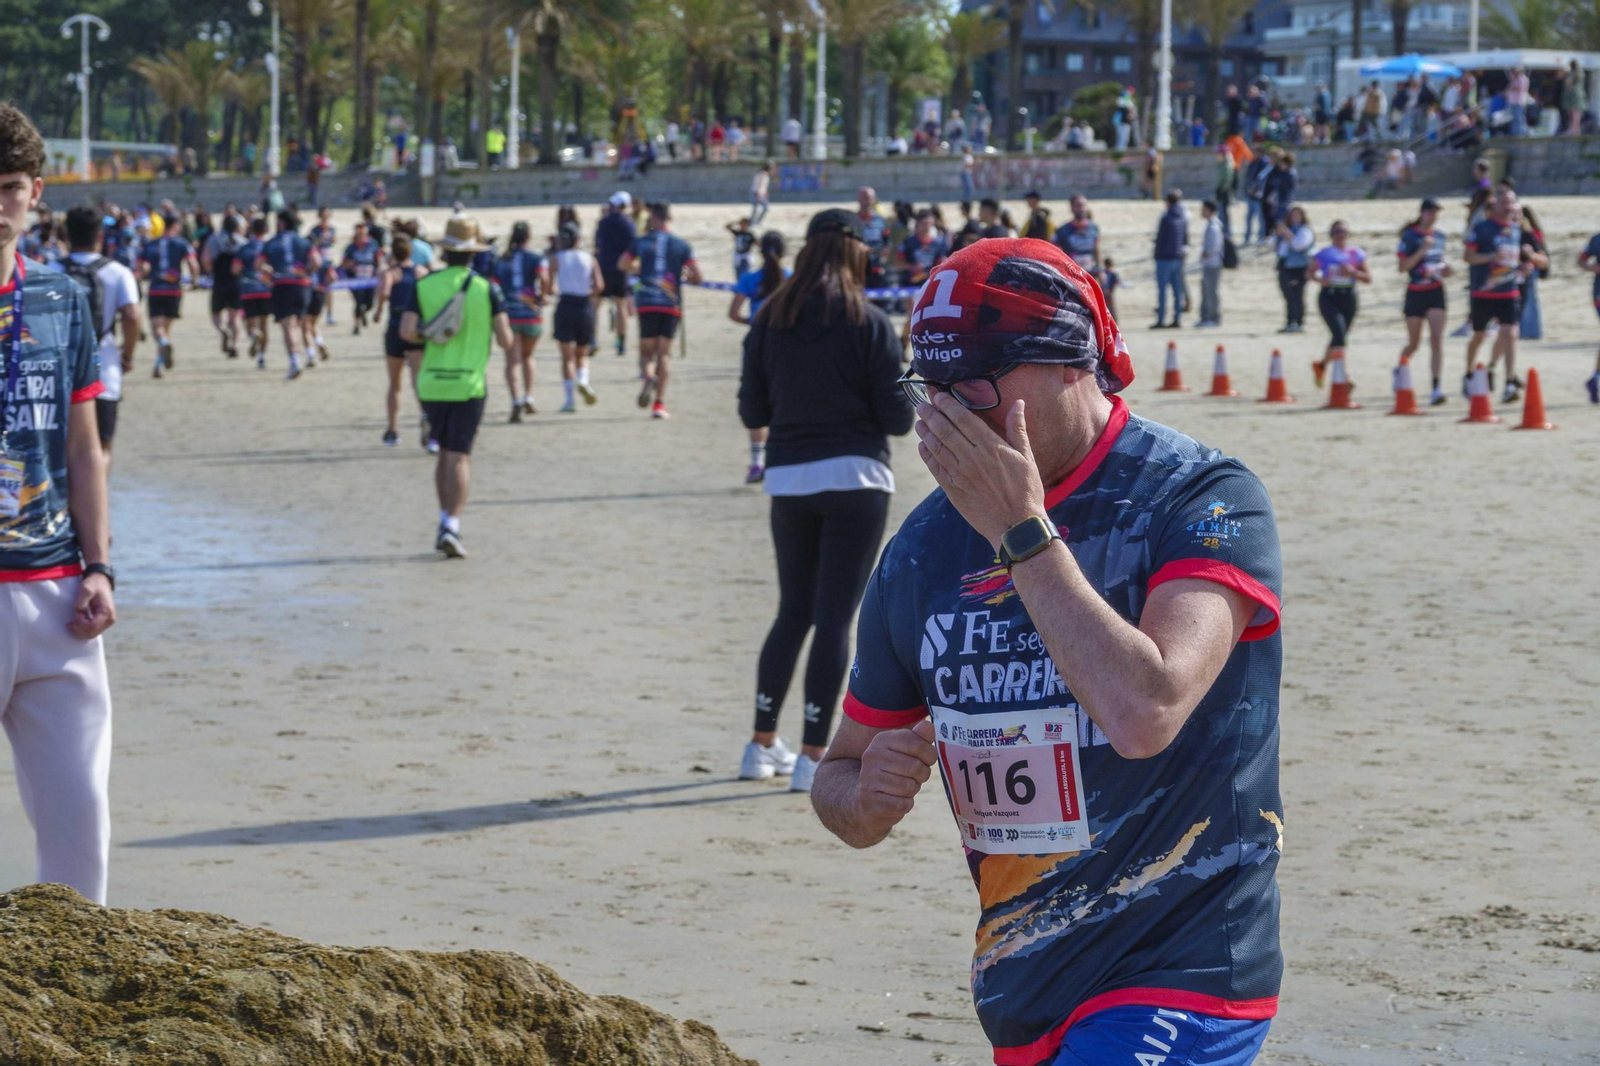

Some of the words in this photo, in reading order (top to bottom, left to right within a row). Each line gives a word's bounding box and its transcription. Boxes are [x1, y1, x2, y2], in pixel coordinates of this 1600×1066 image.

[911, 269, 963, 327] 1
[924, 348, 963, 363] Vigo
[958, 759, 1036, 806] 116
[993, 810, 1020, 818] Vazquez
[986, 828, 1003, 838] 100
